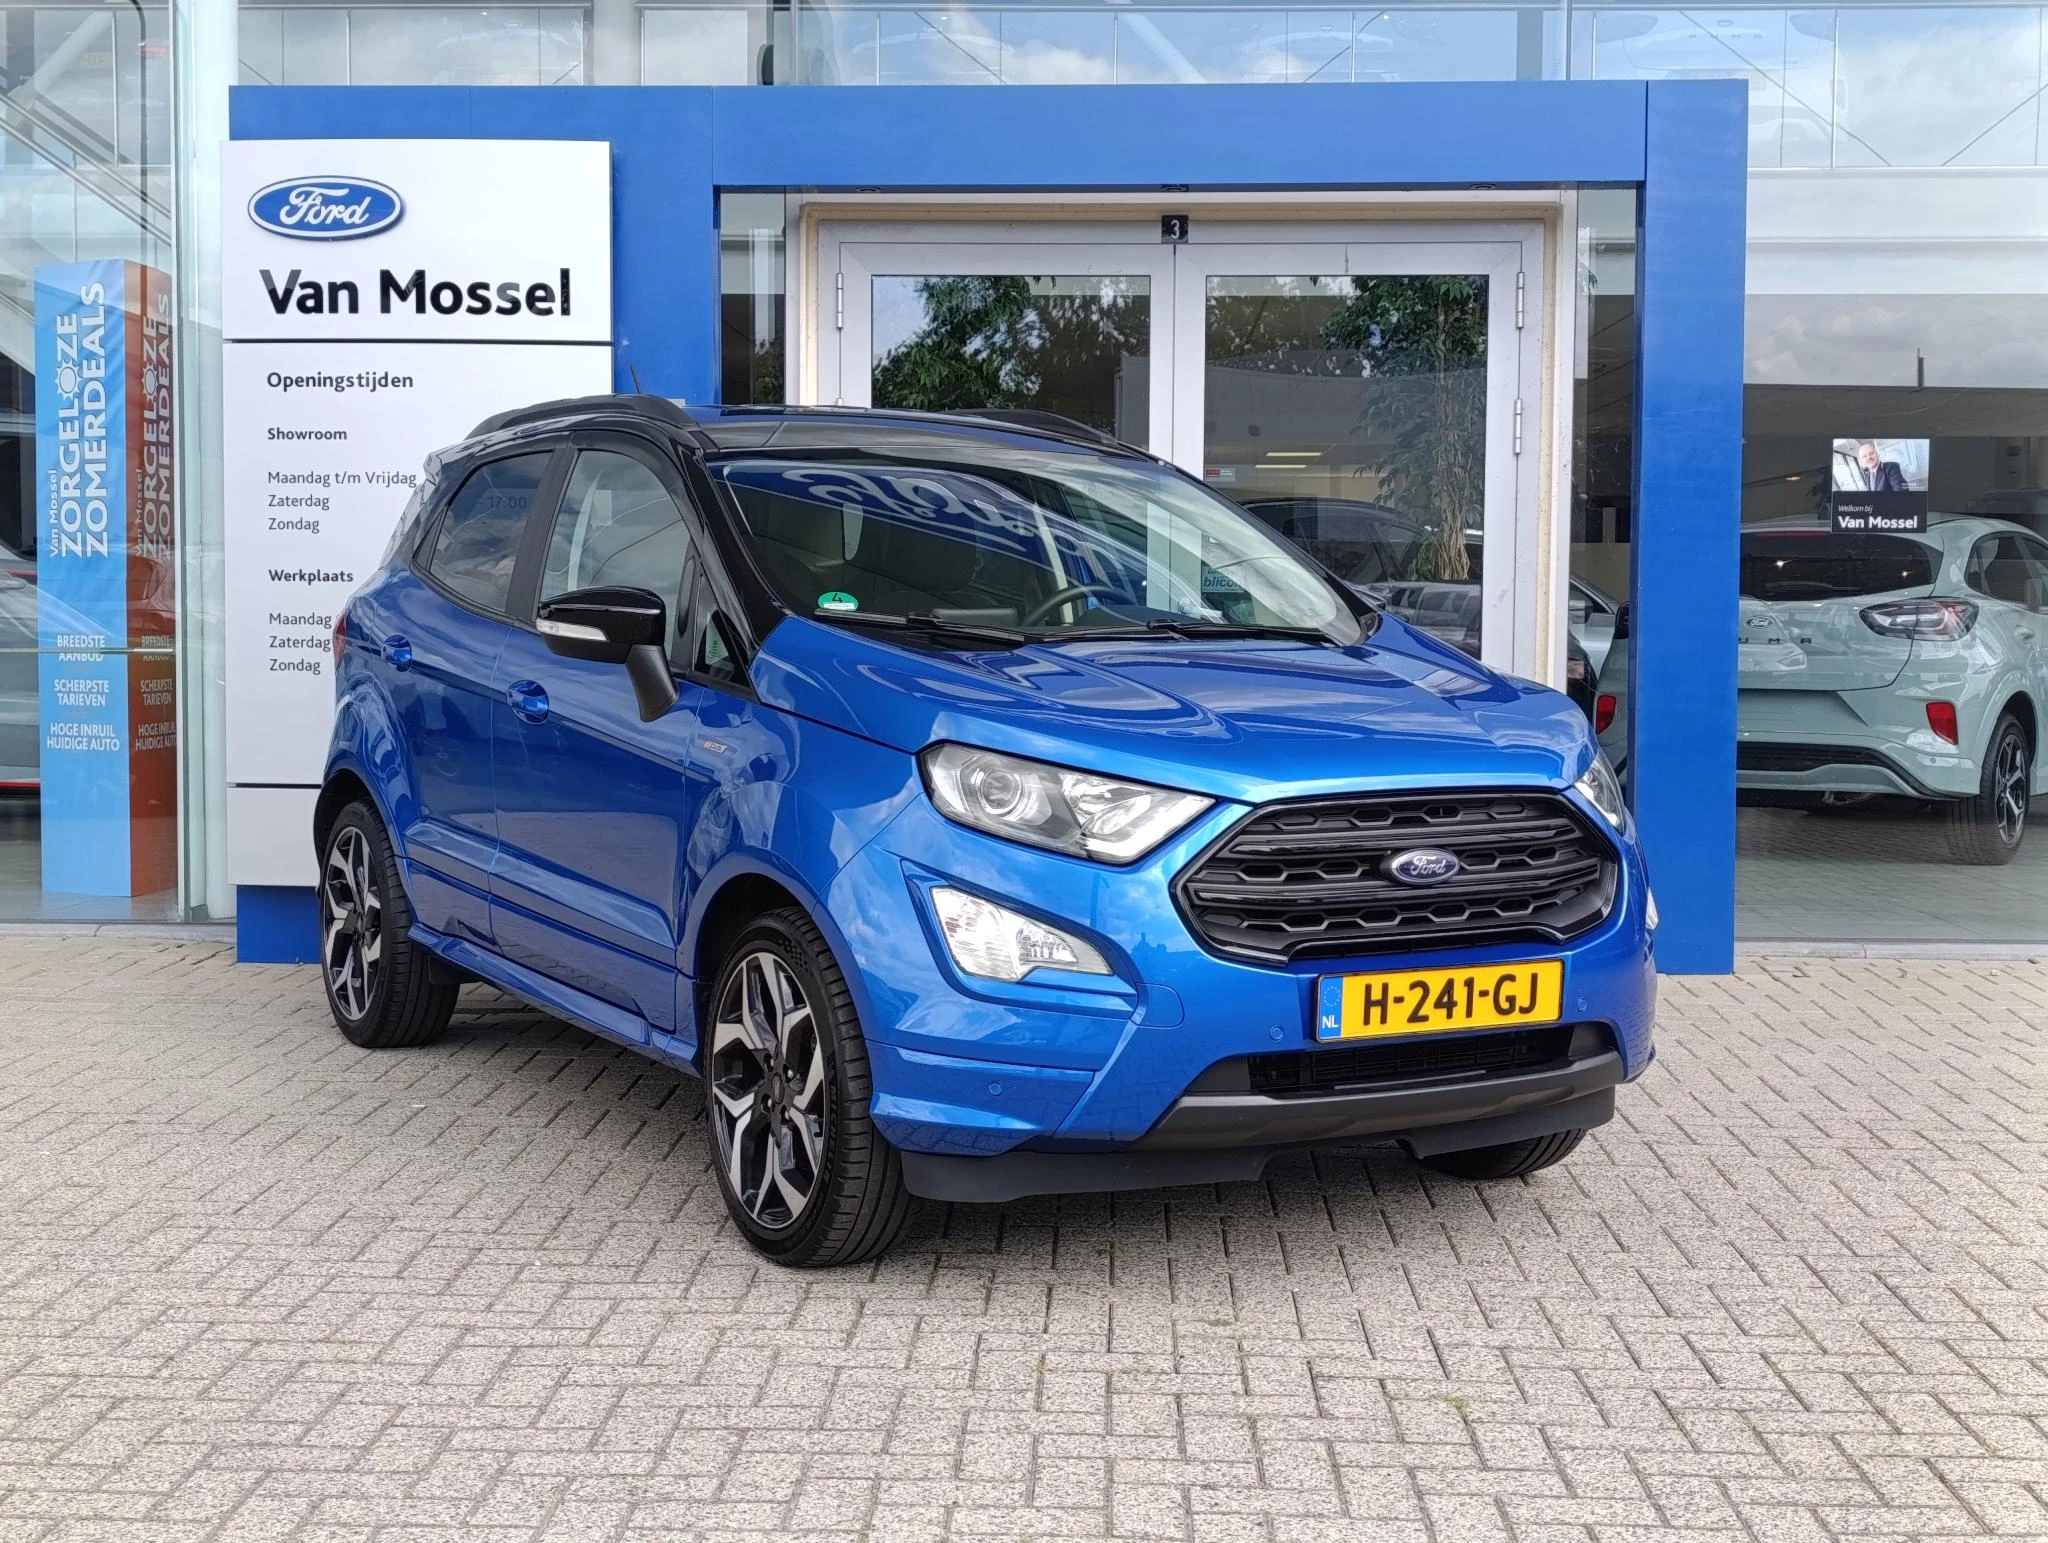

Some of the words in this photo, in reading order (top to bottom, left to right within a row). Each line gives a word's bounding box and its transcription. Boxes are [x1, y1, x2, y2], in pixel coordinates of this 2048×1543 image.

[280, 186, 372, 226] Ford
[1170, 219, 1180, 239] 3
[258, 269, 360, 315] Van
[379, 268, 571, 316] Mossel
[266, 371, 414, 392] Openingstijden
[81, 282, 108, 558] ZOMERDEALS
[158, 293, 171, 560] ZOMERDEALS
[267, 427, 347, 441] Showroom
[267, 471, 331, 488] Maandag
[335, 470, 361, 485] t/m
[365, 471, 417, 488] Vrijdag
[48, 469, 58, 524] Mossel
[267, 494, 330, 511] Zaterdag
[1838, 504, 1864, 512] Welkom
[1865, 504, 1874, 514] bij
[267, 517, 320, 534] Zondag
[1838, 515, 1864, 529] Van
[1868, 515, 1918, 529] Mossel
[49, 528, 59, 557] Van
[268, 569, 354, 585] Werkplaats
[1203, 576, 1238, 588] blico
[831, 592, 844, 604] 4
[268, 612, 332, 629] Maandag
[57, 634, 106, 648] BREEDSTE
[269, 635, 332, 653] Zaterdag
[269, 658, 321, 675] Zondag
[54, 679, 110, 693] SCHERPSTE
[140, 679, 173, 693] SCHERPSTE
[57, 693, 106, 707] TARIEVEN
[143, 692, 172, 706] TARIEVEN
[50, 722, 79, 736] HOGE
[80, 723, 116, 737] INRUIL
[138, 723, 158, 737] HOGE
[47, 736, 89, 750] HUIDIGE
[90, 738, 120, 752] AUTO
[135, 737, 164, 751] HUIDIGE
[1410, 855, 1447, 875] Ford
[1363, 972, 1539, 1026] H-241-GJ
[1322, 1015, 1339, 1029] NL
